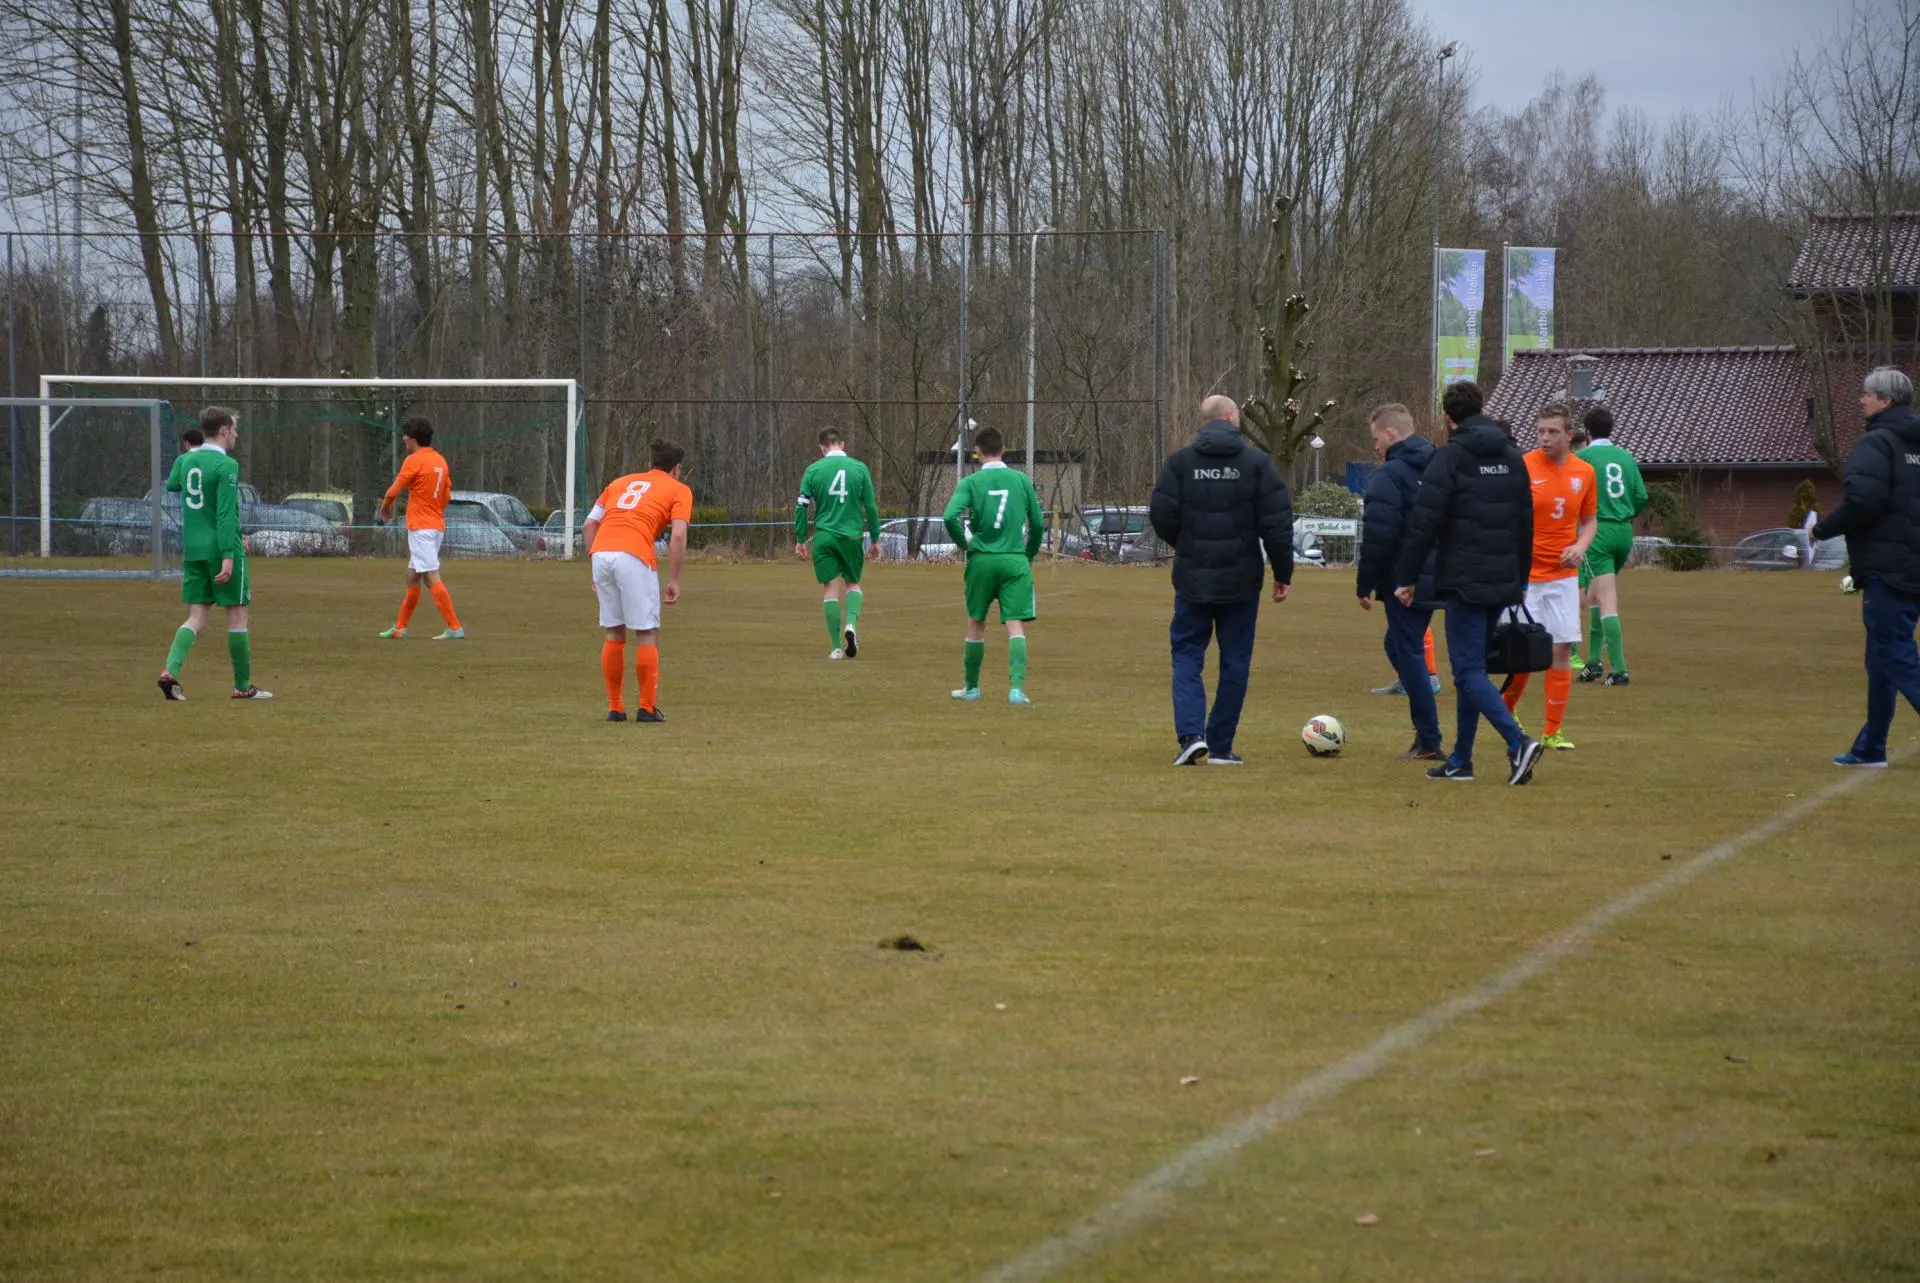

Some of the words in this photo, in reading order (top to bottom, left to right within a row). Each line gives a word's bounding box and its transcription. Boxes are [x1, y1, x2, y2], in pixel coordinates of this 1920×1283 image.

[433, 466, 443, 499] 7
[829, 469, 849, 504] 4
[1194, 469, 1221, 480] ING
[1480, 466, 1497, 474] ING
[1606, 462, 1625, 499] 8
[186, 467, 204, 510] 9
[616, 480, 652, 510] 8
[987, 489, 1009, 529] 7
[1551, 497, 1566, 520] 3
